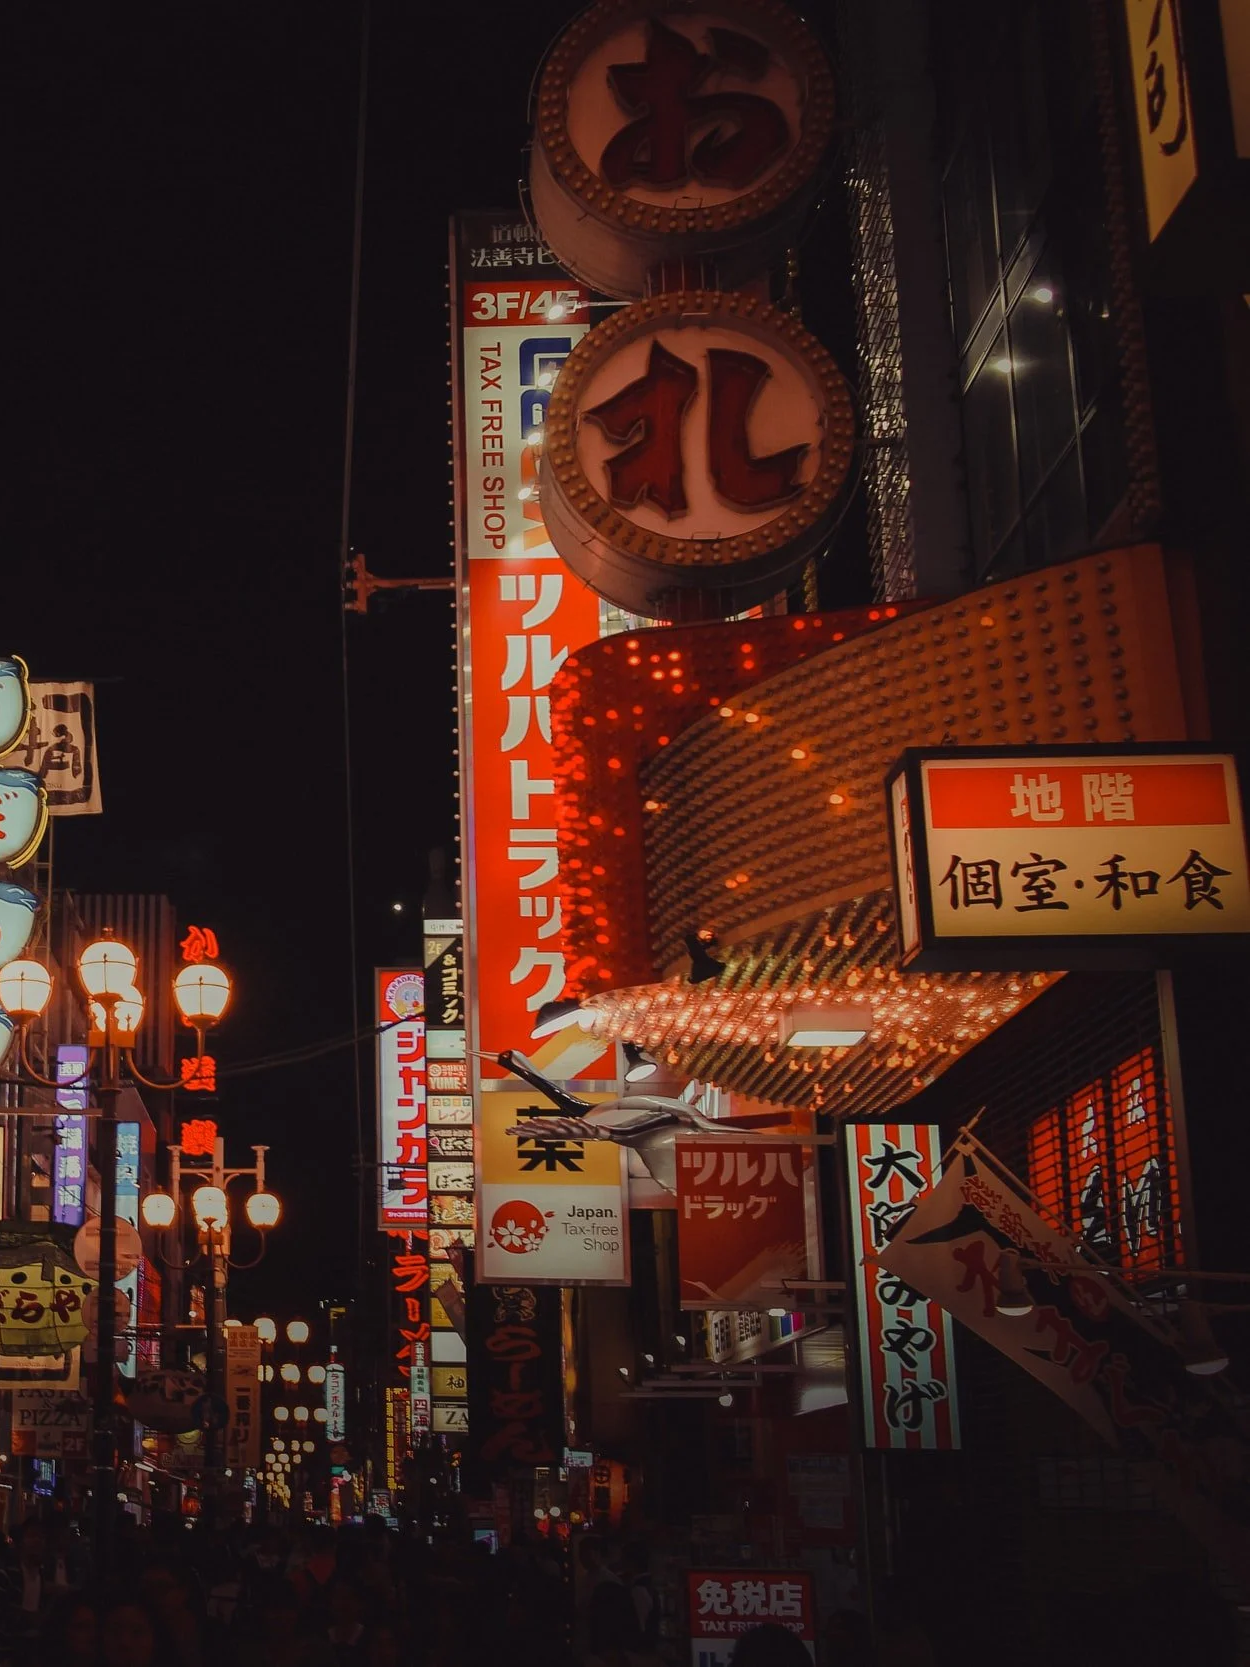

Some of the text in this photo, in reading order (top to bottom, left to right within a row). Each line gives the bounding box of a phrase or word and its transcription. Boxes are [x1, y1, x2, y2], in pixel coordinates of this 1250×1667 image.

[480, 342, 506, 550] TAX FREE SHOP
[1009, 772, 1136, 823] 地階
[938, 849, 1234, 913] 個室・和食
[681, 1151, 799, 1187] ツルハ
[567, 1205, 618, 1221] Japan.
[684, 1195, 778, 1220] ドラッグ
[561, 1222, 619, 1237] Tax-free
[583, 1237, 620, 1253] Shop
[481, 1324, 557, 1463] らーめん
[20, 1408, 83, 1426] PIZZA
[696, 1579, 803, 1617] 免税店
[699, 1620, 726, 1633] TAX
